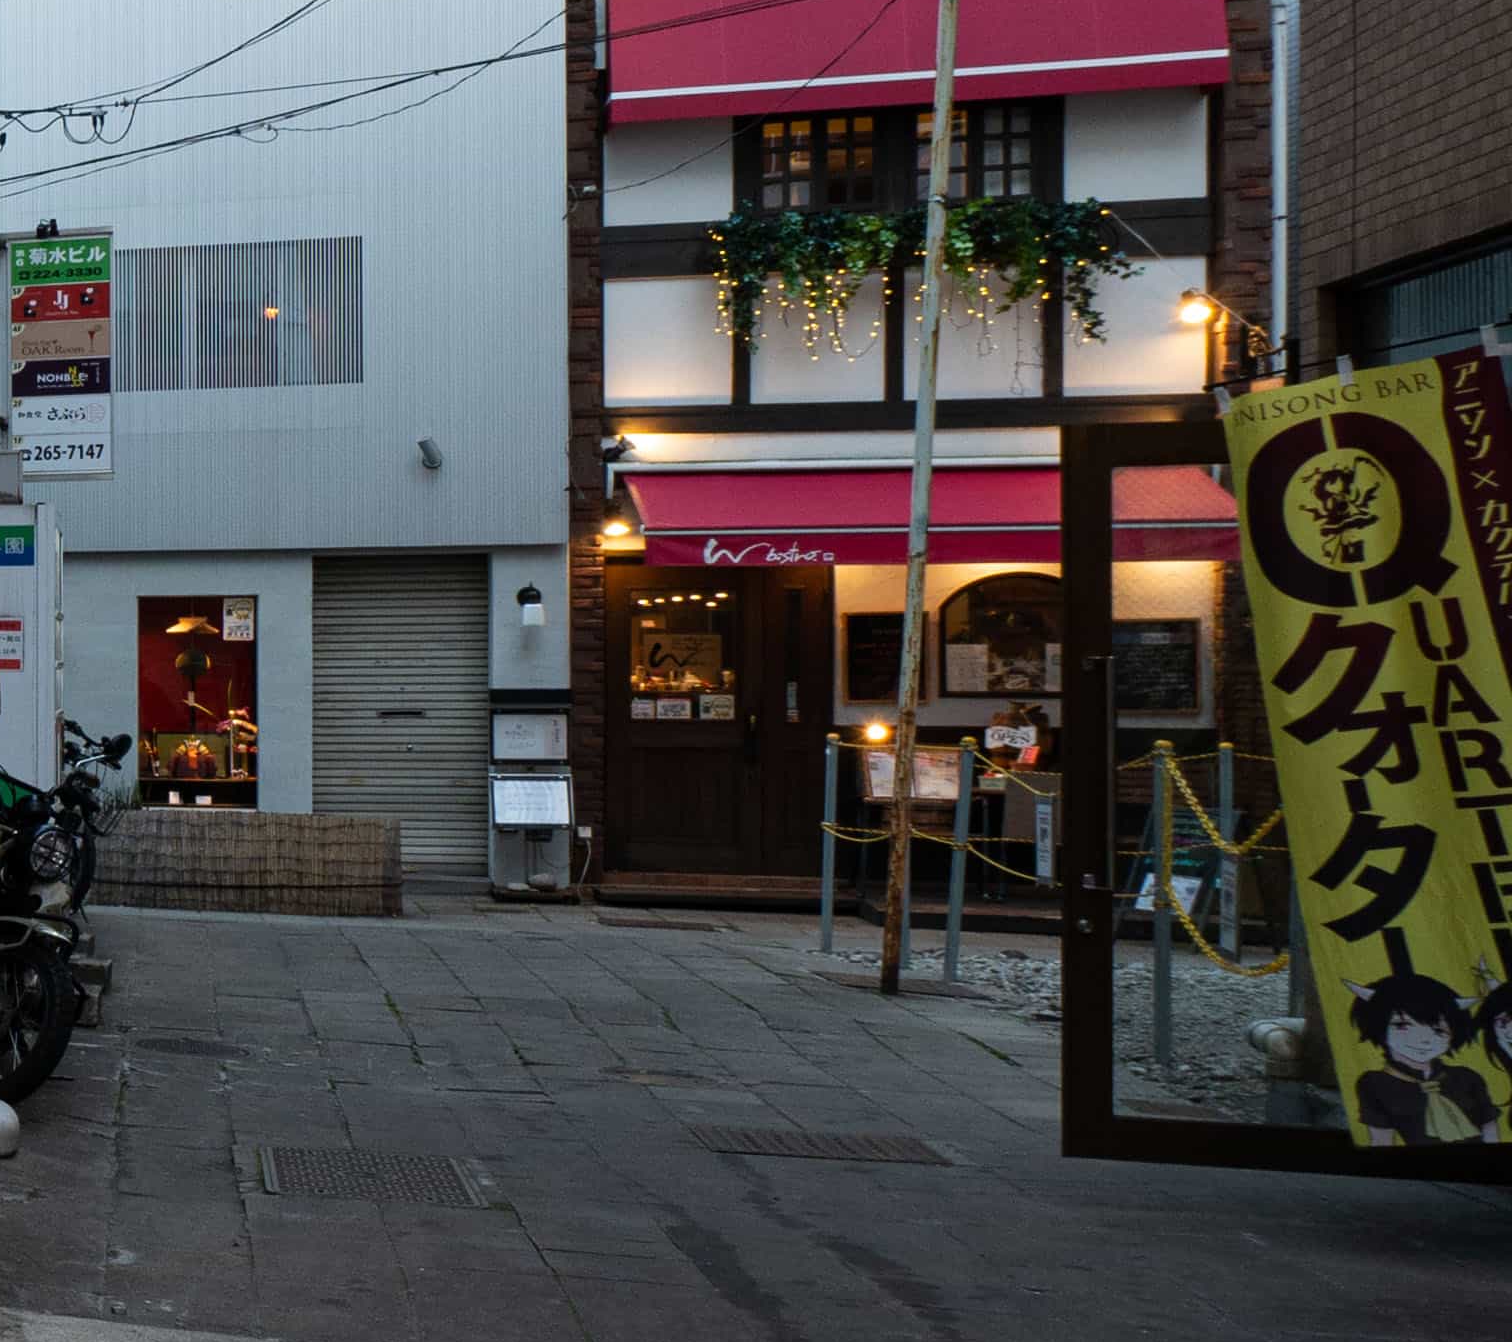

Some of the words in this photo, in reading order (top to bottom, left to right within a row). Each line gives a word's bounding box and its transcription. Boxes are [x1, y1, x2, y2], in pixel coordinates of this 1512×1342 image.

[28, 245, 107, 265] 菊水ビル
[21, 346, 52, 356] OAK
[55, 345, 85, 355] Room
[1234, 385, 1362, 428] NISONG
[1375, 372, 1436, 400] BAR
[47, 407, 86, 421] さぶら
[34, 444, 104, 461] 265-7147
